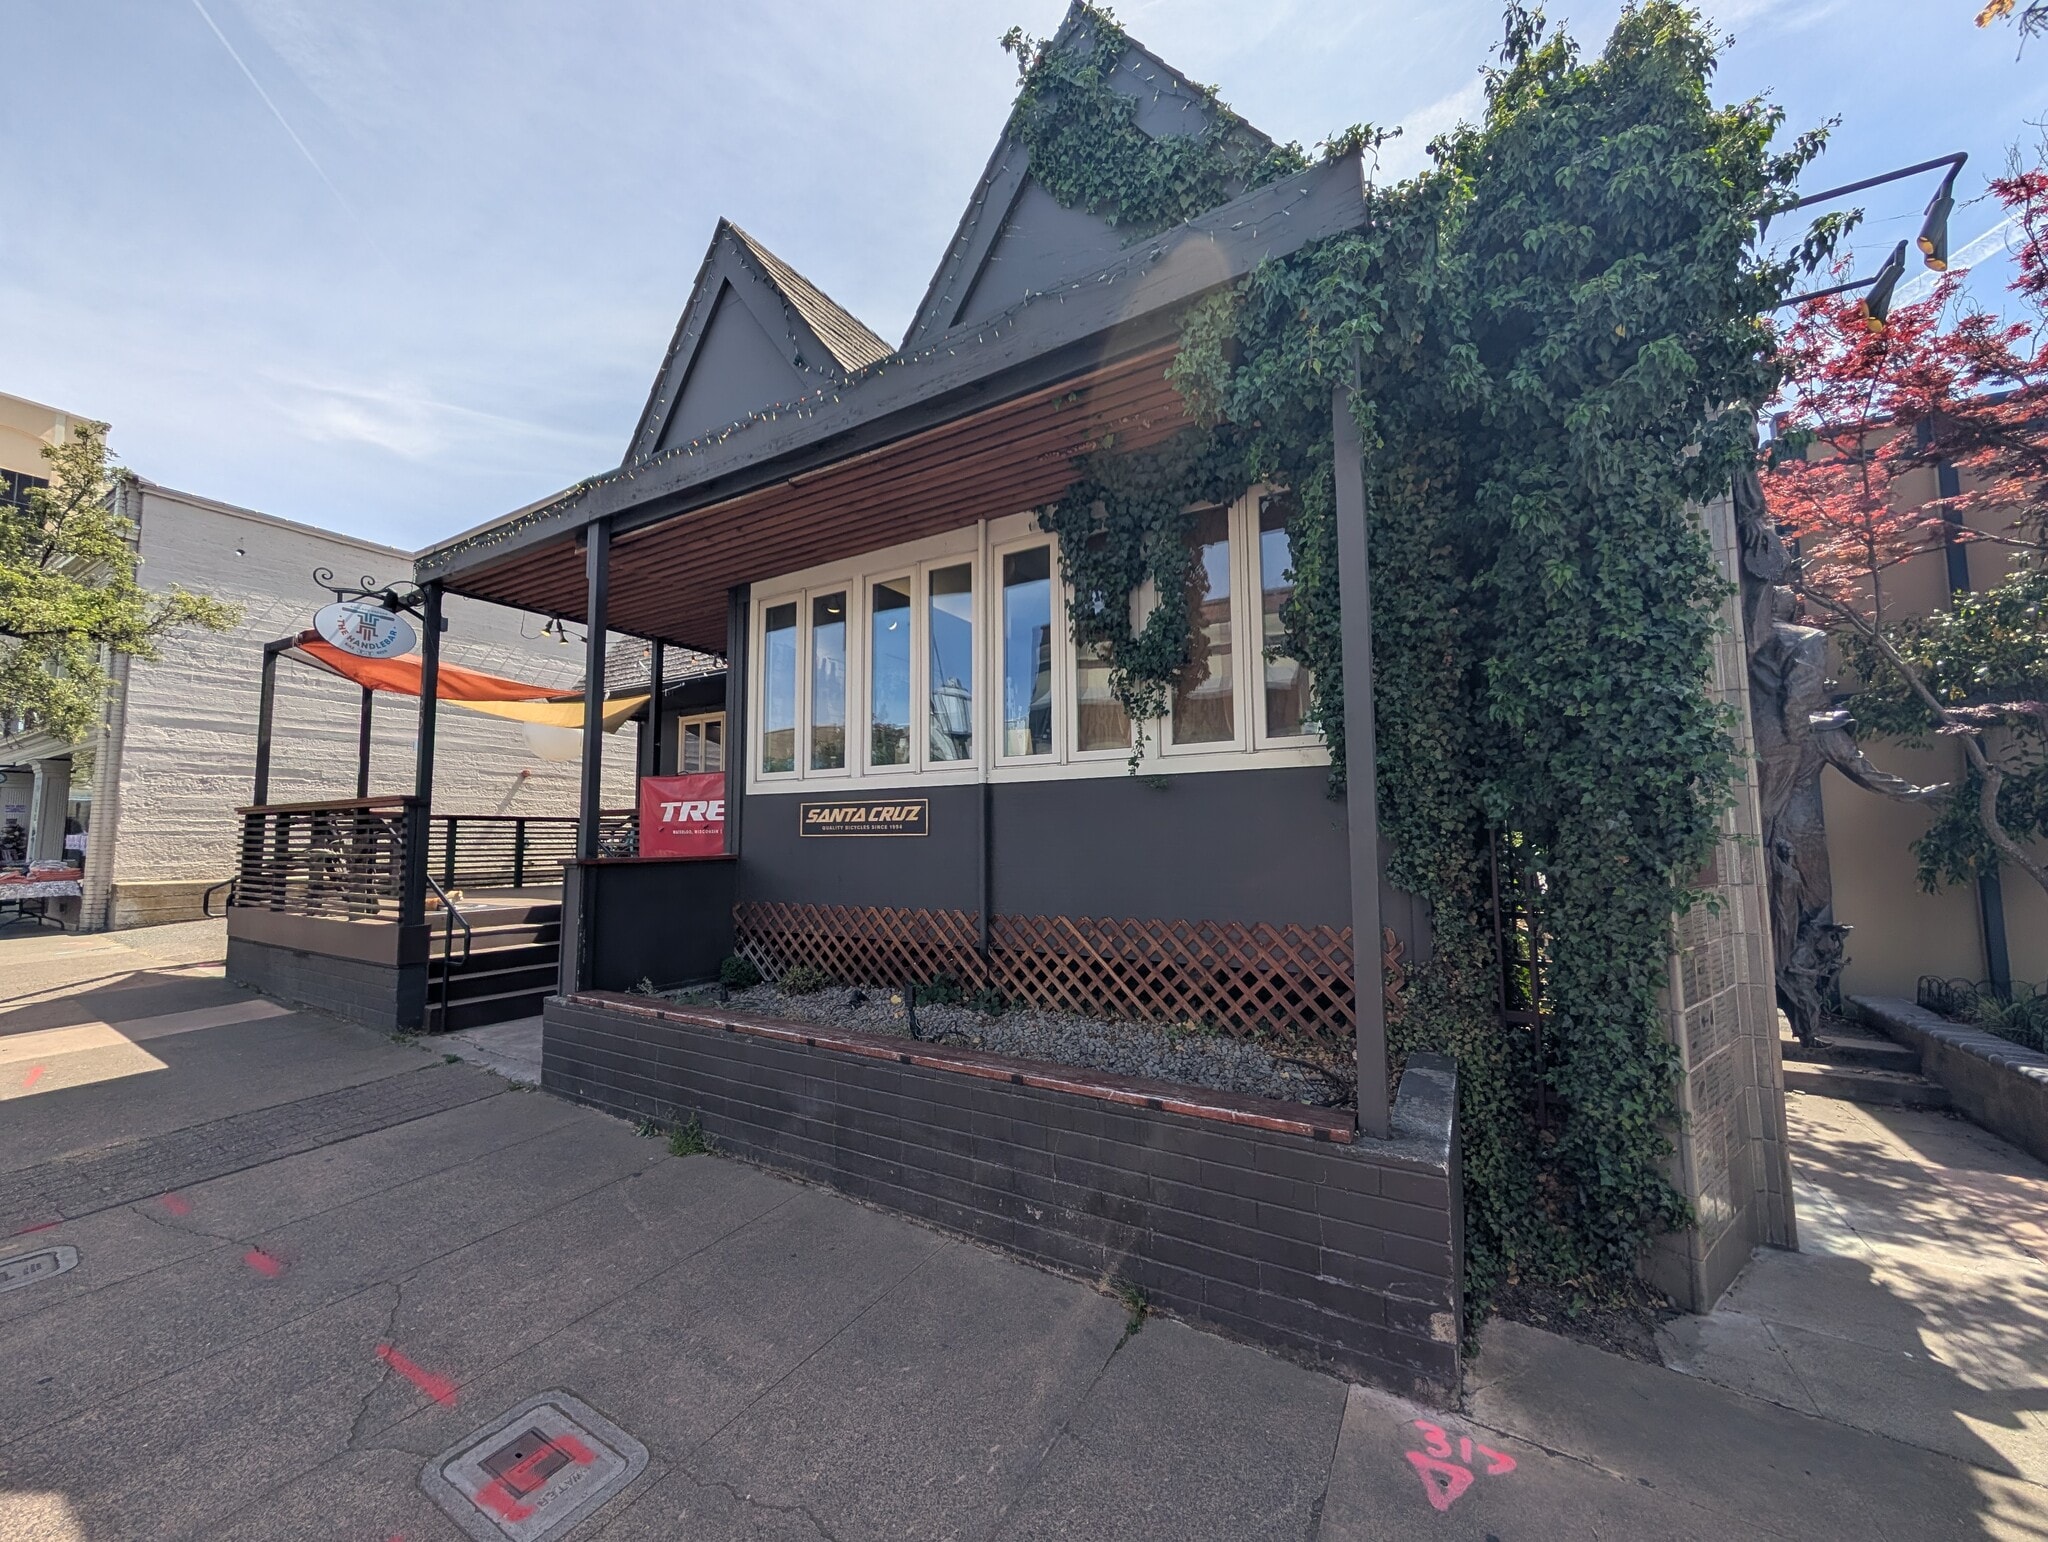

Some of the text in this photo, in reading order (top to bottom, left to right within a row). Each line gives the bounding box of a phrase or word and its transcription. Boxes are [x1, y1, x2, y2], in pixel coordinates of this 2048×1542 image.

[336, 619, 398, 650] THE HANDLEBAR
[660, 800, 725, 822] TRE
[805, 805, 922, 823] SANTA CRUZ
